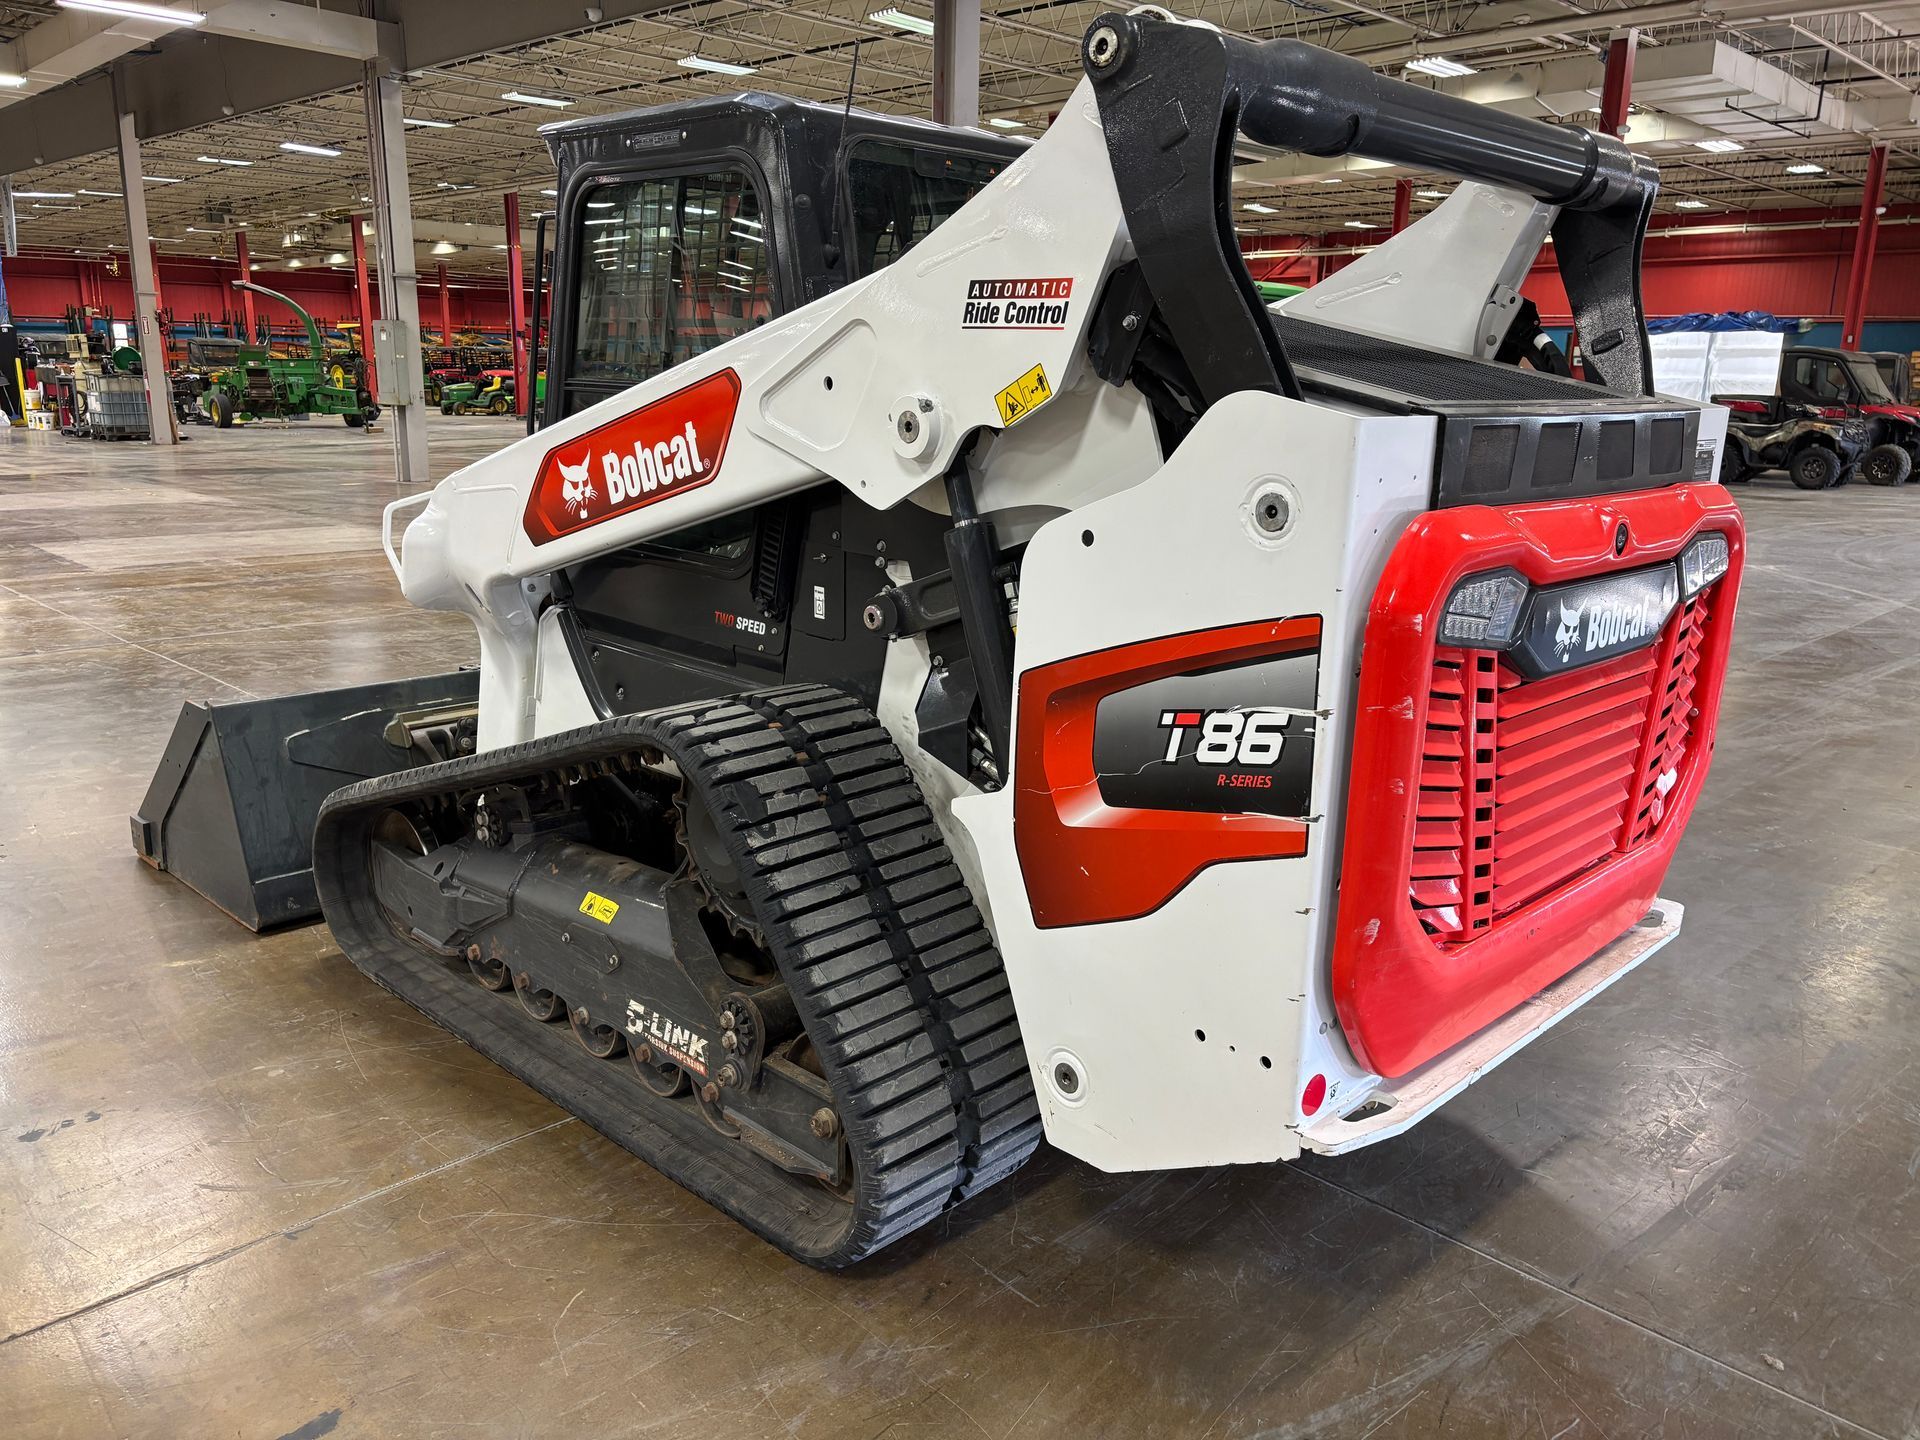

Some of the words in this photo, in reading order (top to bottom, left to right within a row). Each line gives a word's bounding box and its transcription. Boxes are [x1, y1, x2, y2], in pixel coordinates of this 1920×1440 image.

[971, 281, 1069, 297] AUTOMATIC
[963, 301, 1000, 324] Ride
[1004, 301, 1069, 324] Control
[602, 421, 704, 504] Bobcat
[714, 610, 735, 628] TWO
[736, 616, 766, 635] SPEED
[1585, 594, 1650, 652] Bobcat
[1161, 712, 1290, 764] T86
[1217, 774, 1272, 788] R-SERIES
